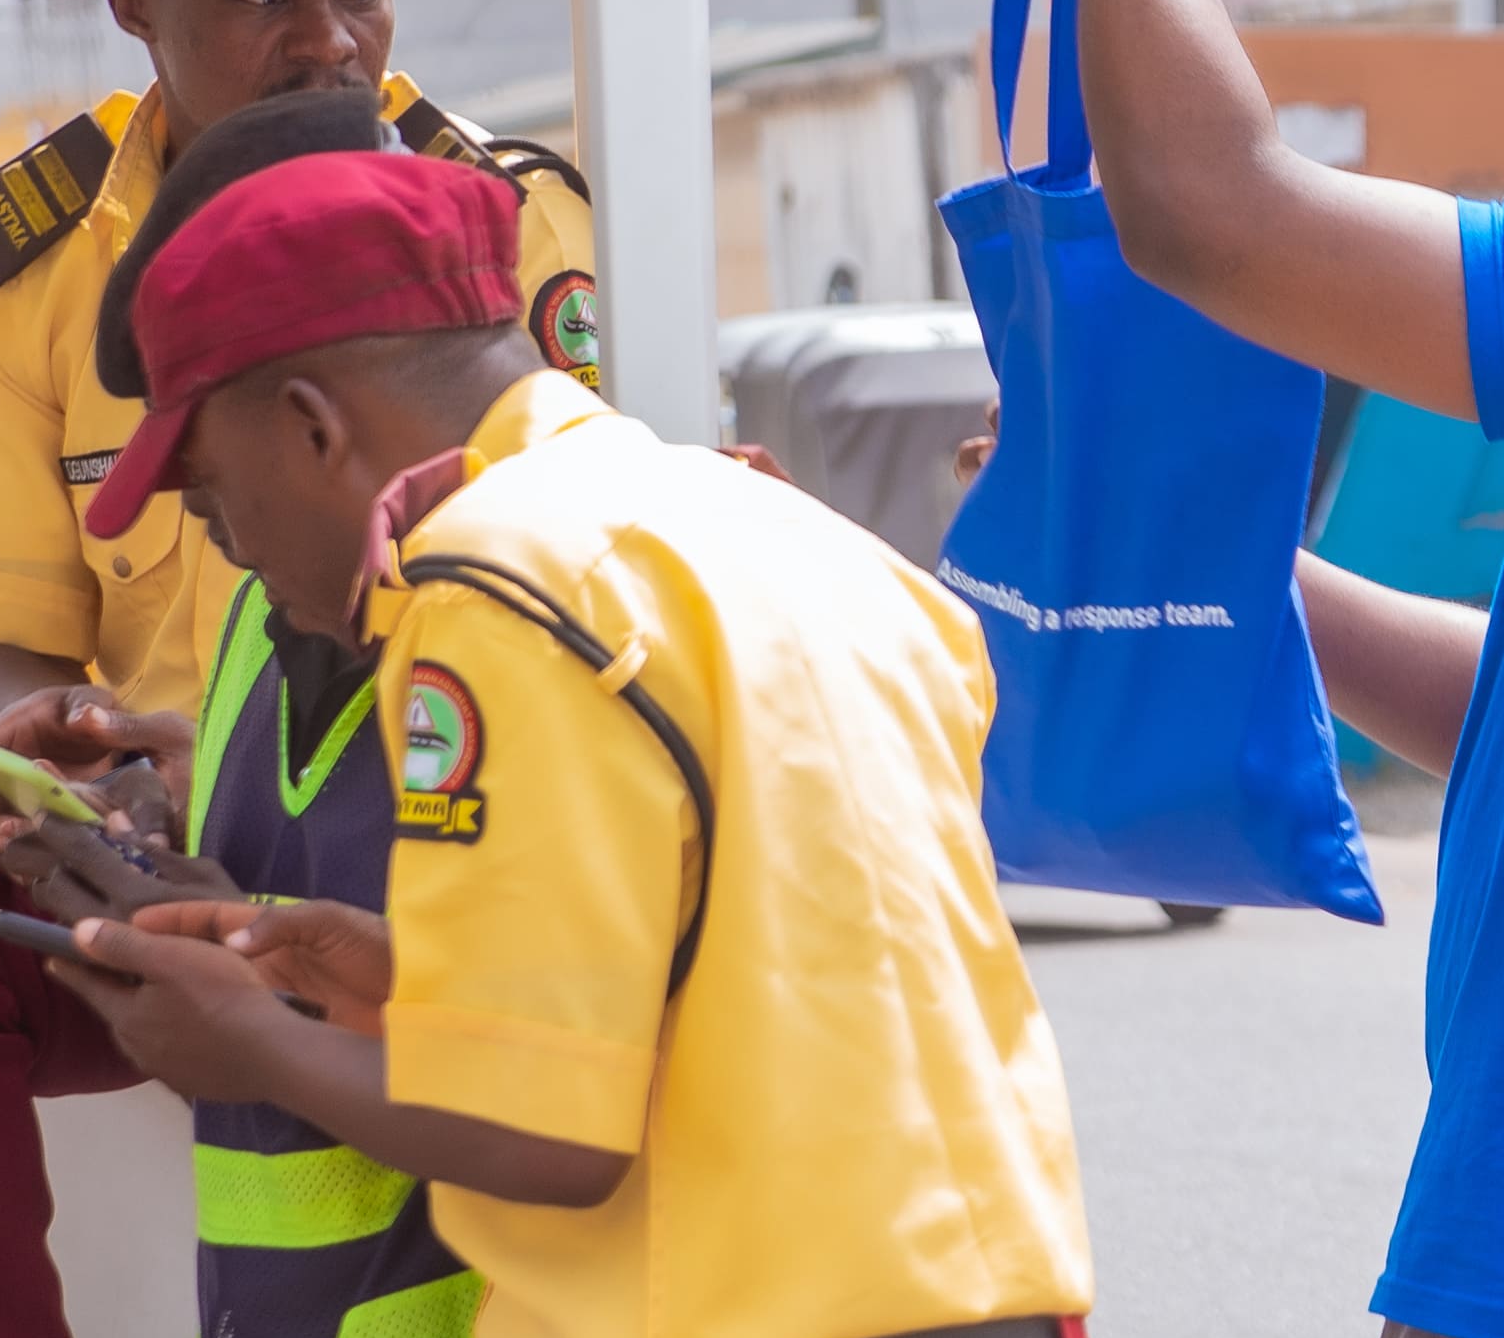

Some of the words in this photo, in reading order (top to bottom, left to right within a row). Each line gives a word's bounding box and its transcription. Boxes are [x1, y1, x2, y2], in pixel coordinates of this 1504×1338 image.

[936, 556, 1041, 632] Assembling
[1044, 608, 1062, 631] a
[1064, 605, 1162, 634] response
[1165, 600, 1235, 629] team.
